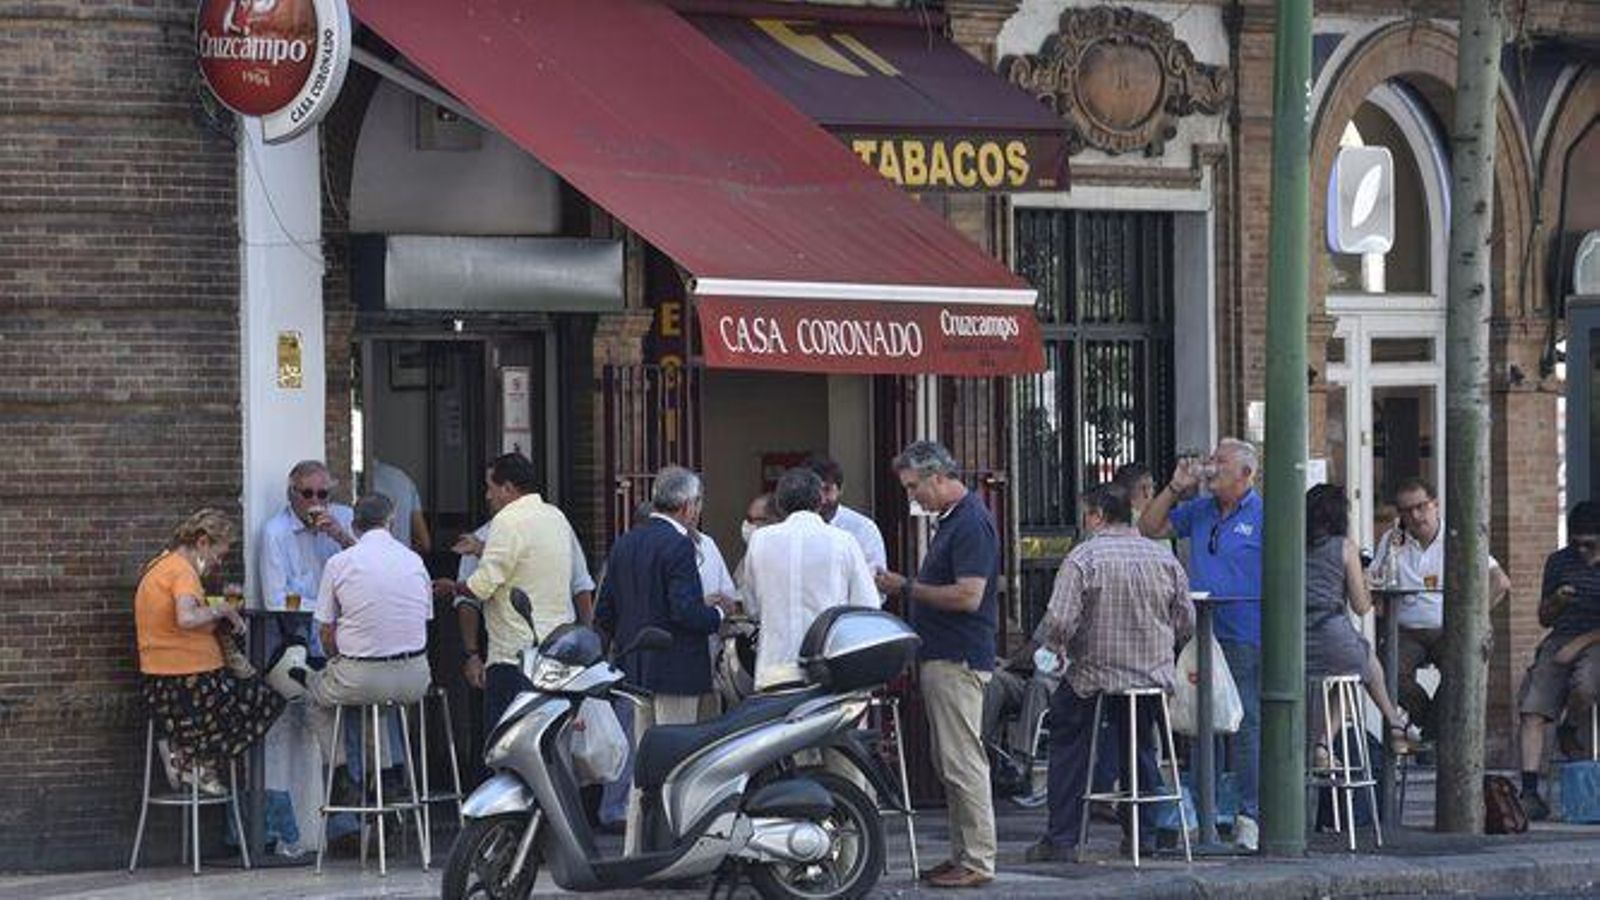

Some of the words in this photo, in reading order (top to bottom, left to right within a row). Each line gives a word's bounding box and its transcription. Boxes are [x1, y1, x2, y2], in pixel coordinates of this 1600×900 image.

[200, 31, 307, 65] Cruzcampo
[290, 97, 315, 123] CASA
[311, 28, 335, 98] CORONADO
[852, 139, 1029, 187] TABACOS
[719, 316, 788, 354] CASA
[796, 318, 924, 358] CORONADO
